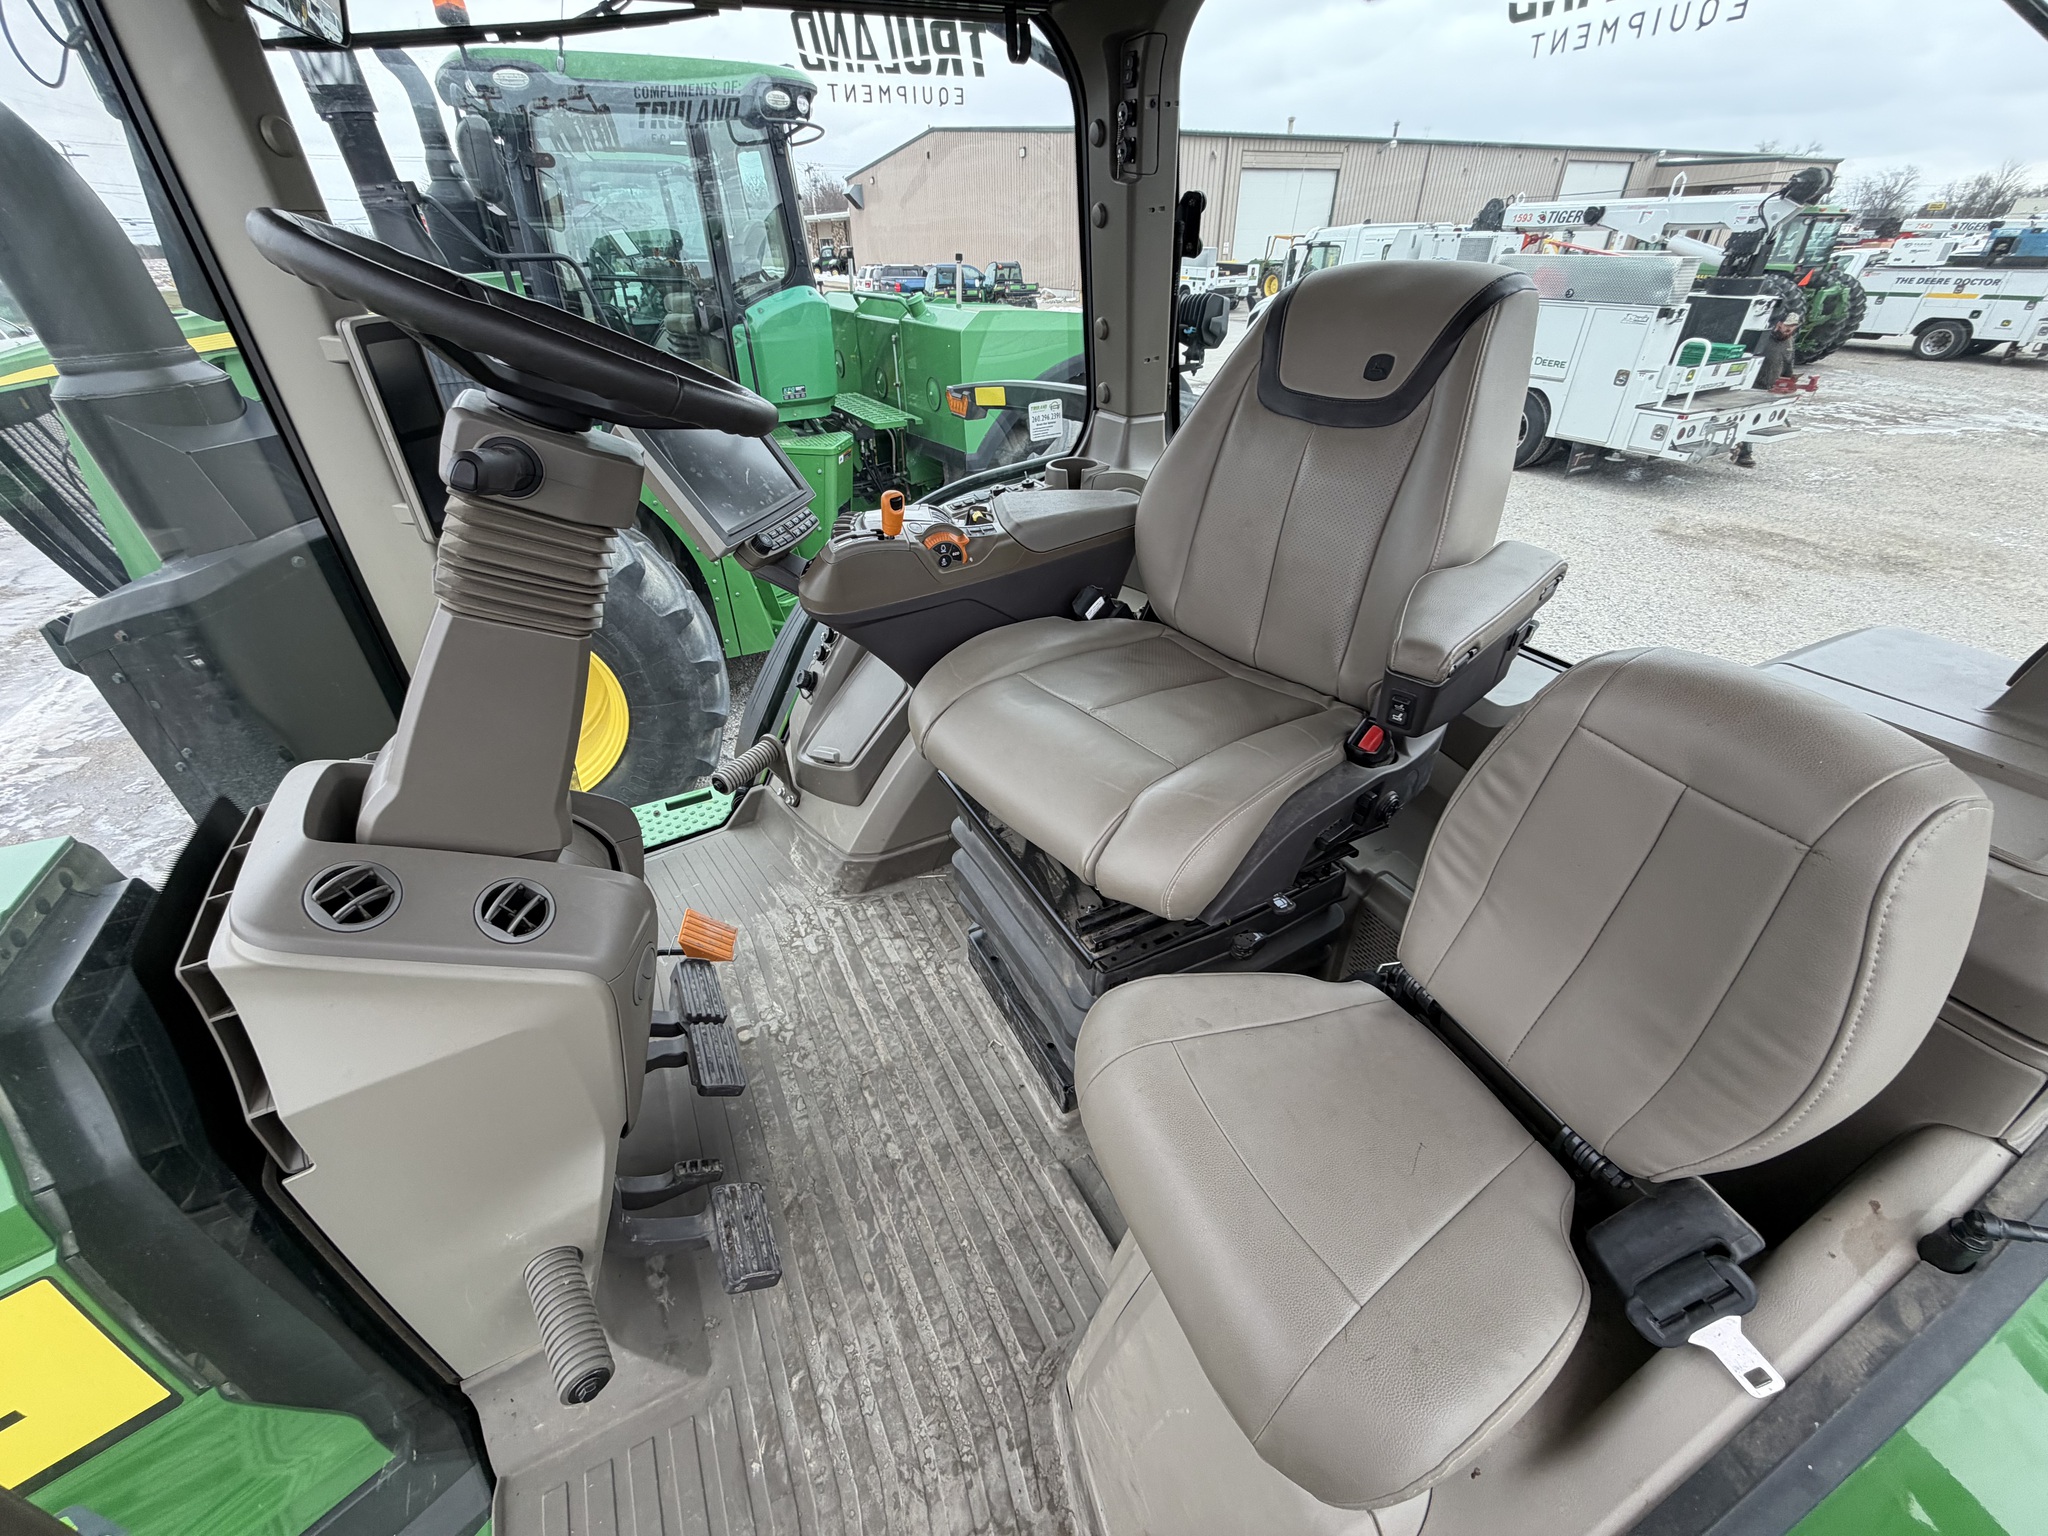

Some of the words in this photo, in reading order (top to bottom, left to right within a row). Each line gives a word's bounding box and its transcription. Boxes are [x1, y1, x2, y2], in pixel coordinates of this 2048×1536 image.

[633, 82, 717, 99] COMPLIMENTS
[723, 80, 742, 94] OF:
[635, 97, 741, 129] TRULAND
[1512, 213, 1533, 223] 1593
[1547, 210, 1584, 223] TIGER
[1957, 221, 1989, 231] TIGER
[1895, 277, 1915, 285] THE
[1915, 277, 1951, 285] DEERE
[1953, 278, 2002, 287] DOCTOR
[1534, 356, 1567, 369] DEERE
